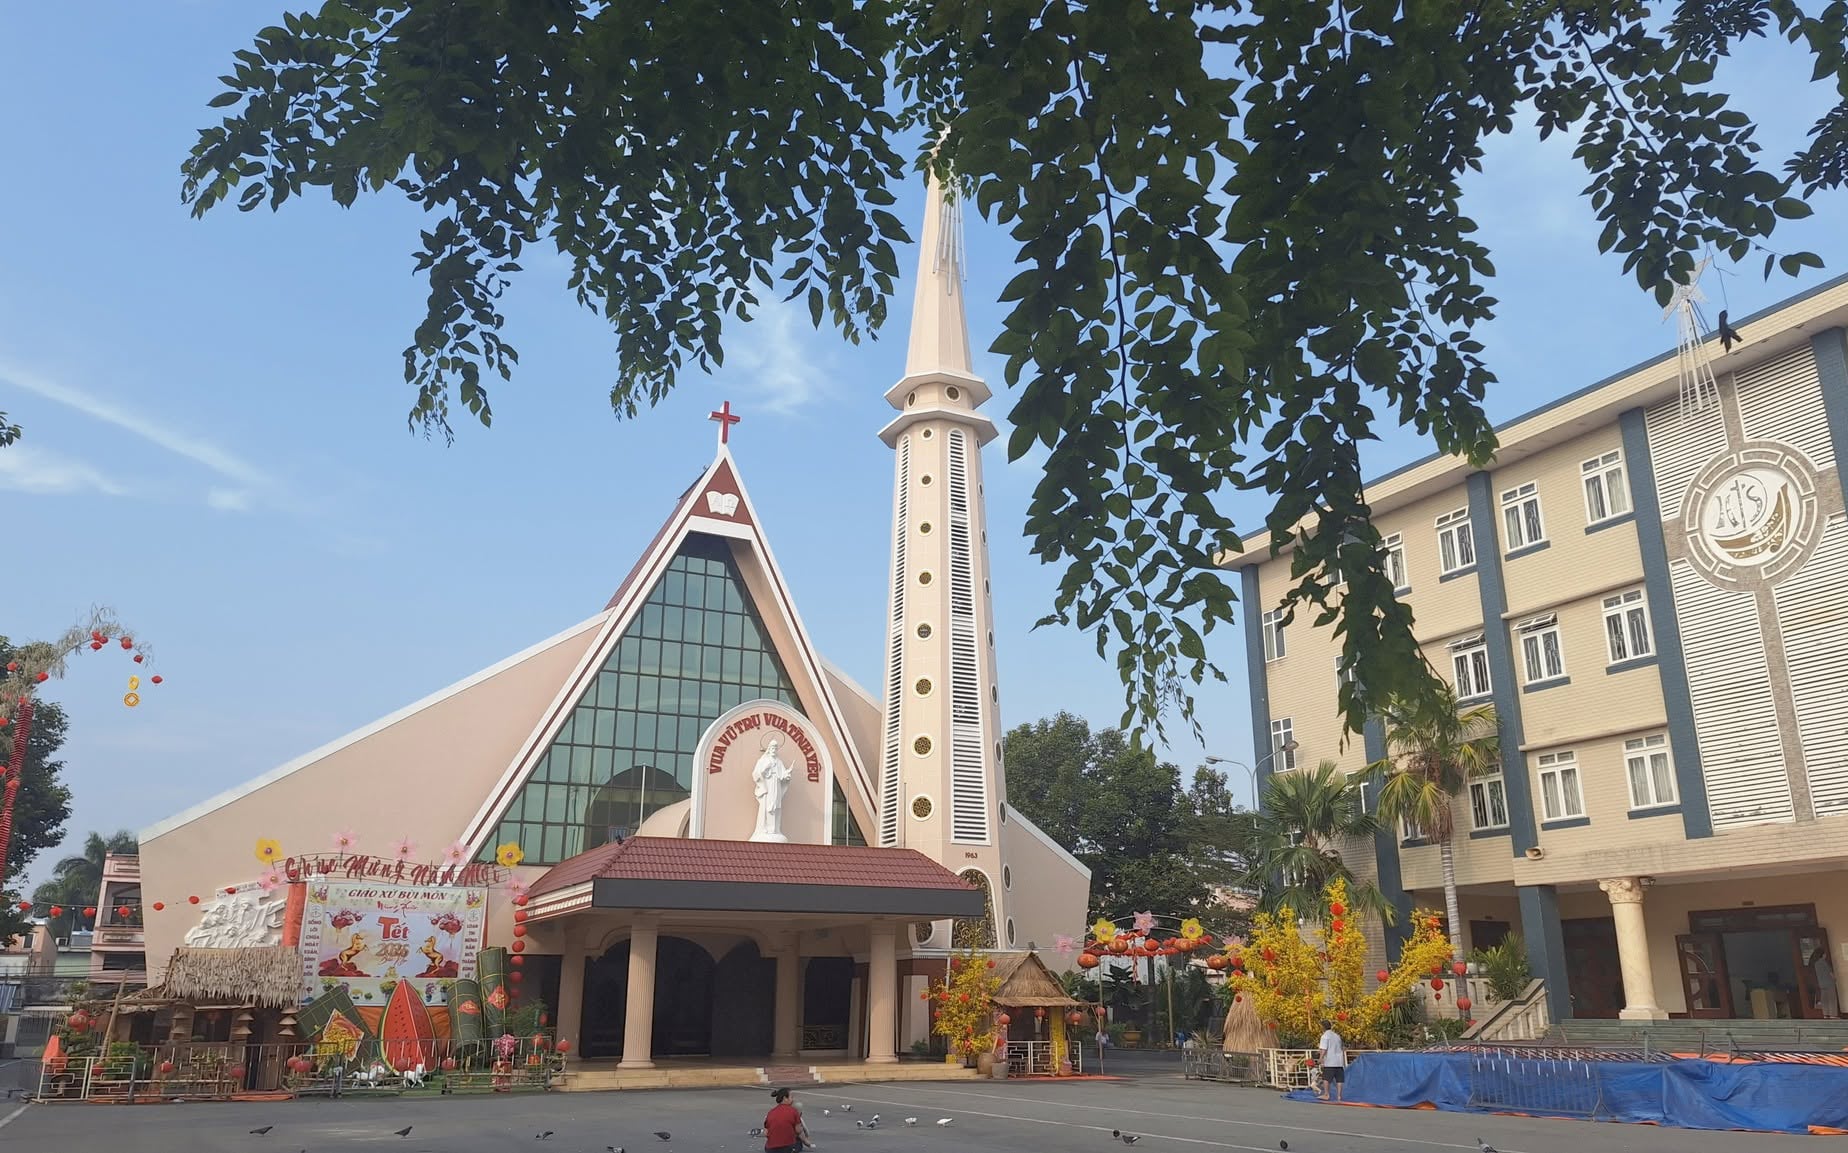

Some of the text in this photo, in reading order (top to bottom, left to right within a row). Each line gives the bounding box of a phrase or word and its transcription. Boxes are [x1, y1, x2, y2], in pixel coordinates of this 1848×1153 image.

[709, 712, 822, 783] VUA VŨ TRỤ VUA TÌNH YÊU
[378, 916, 410, 940] Tết
